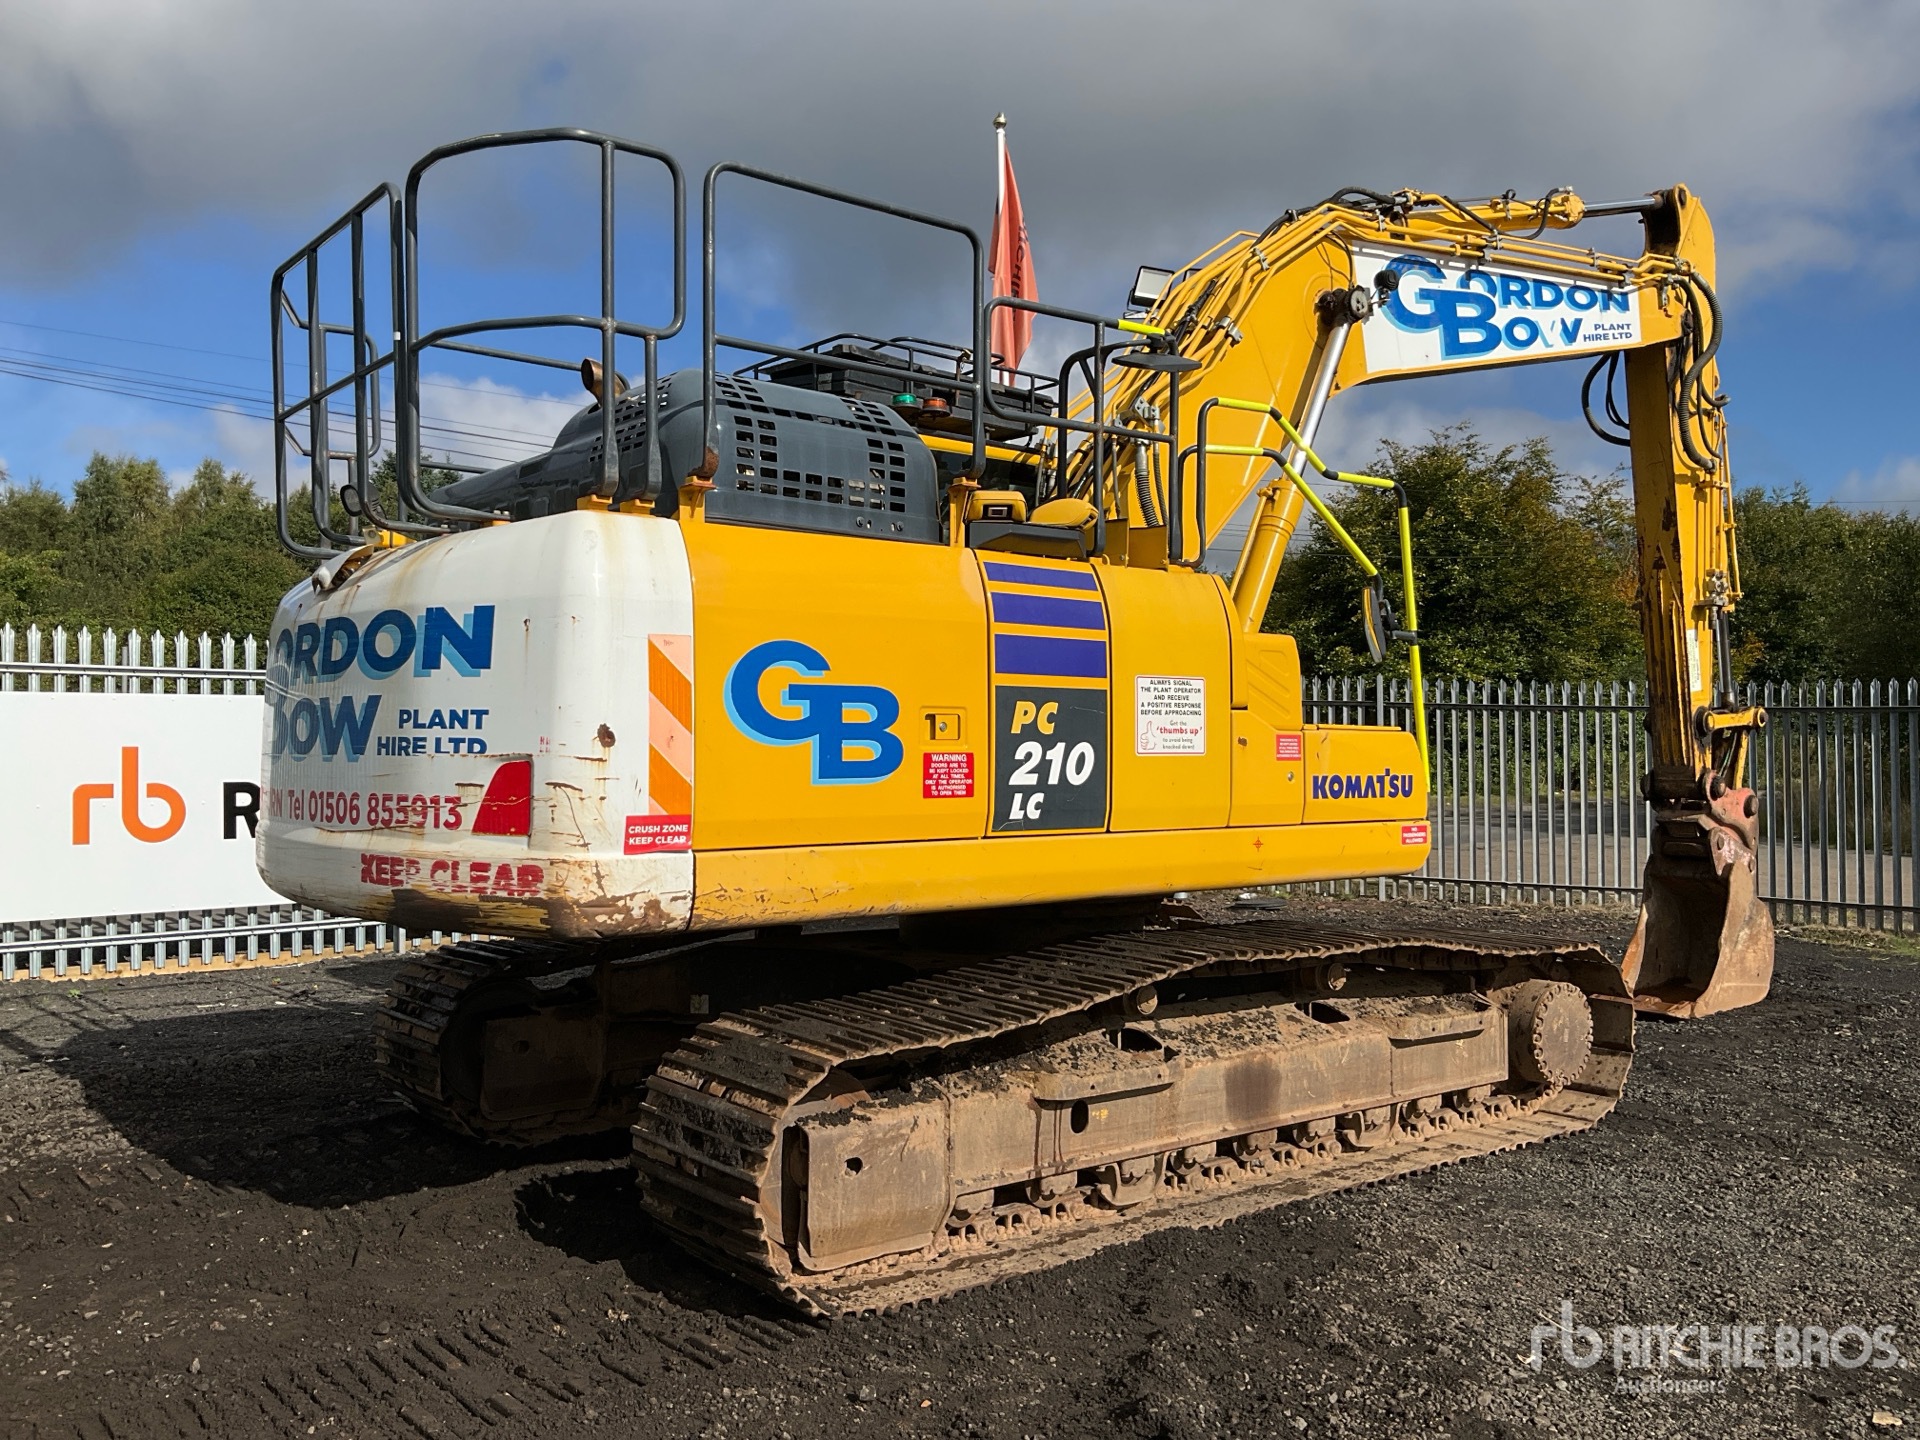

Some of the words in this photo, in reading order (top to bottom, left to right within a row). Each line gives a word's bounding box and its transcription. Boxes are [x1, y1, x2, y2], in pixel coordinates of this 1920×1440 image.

[1381, 254, 1630, 334] GORDON
[1583, 333, 1610, 342] HIRE
[1612, 332, 1632, 340] LTD
[1594, 323, 1632, 331] PLANT
[398, 709, 489, 730] PLANT
[723, 639, 904, 785] GB
[1010, 701, 1058, 734] PC
[377, 737, 427, 756] HIRE
[436, 737, 488, 755] LTD
[1008, 741, 1095, 786] 210
[72, 746, 186, 845] rb
[1312, 768, 1413, 799] KOMATSU
[288, 789, 305, 820] Tel
[308, 790, 360, 825] 01506
[367, 792, 463, 830] 855913
[1008, 792, 1045, 820] LC
[628, 825, 660, 834] CRUSH
[662, 824, 688, 833] ZONE
[628, 836, 654, 846] KEEP
[655, 835, 687, 845] CLEAR
[361, 852, 421, 887] KEEP
